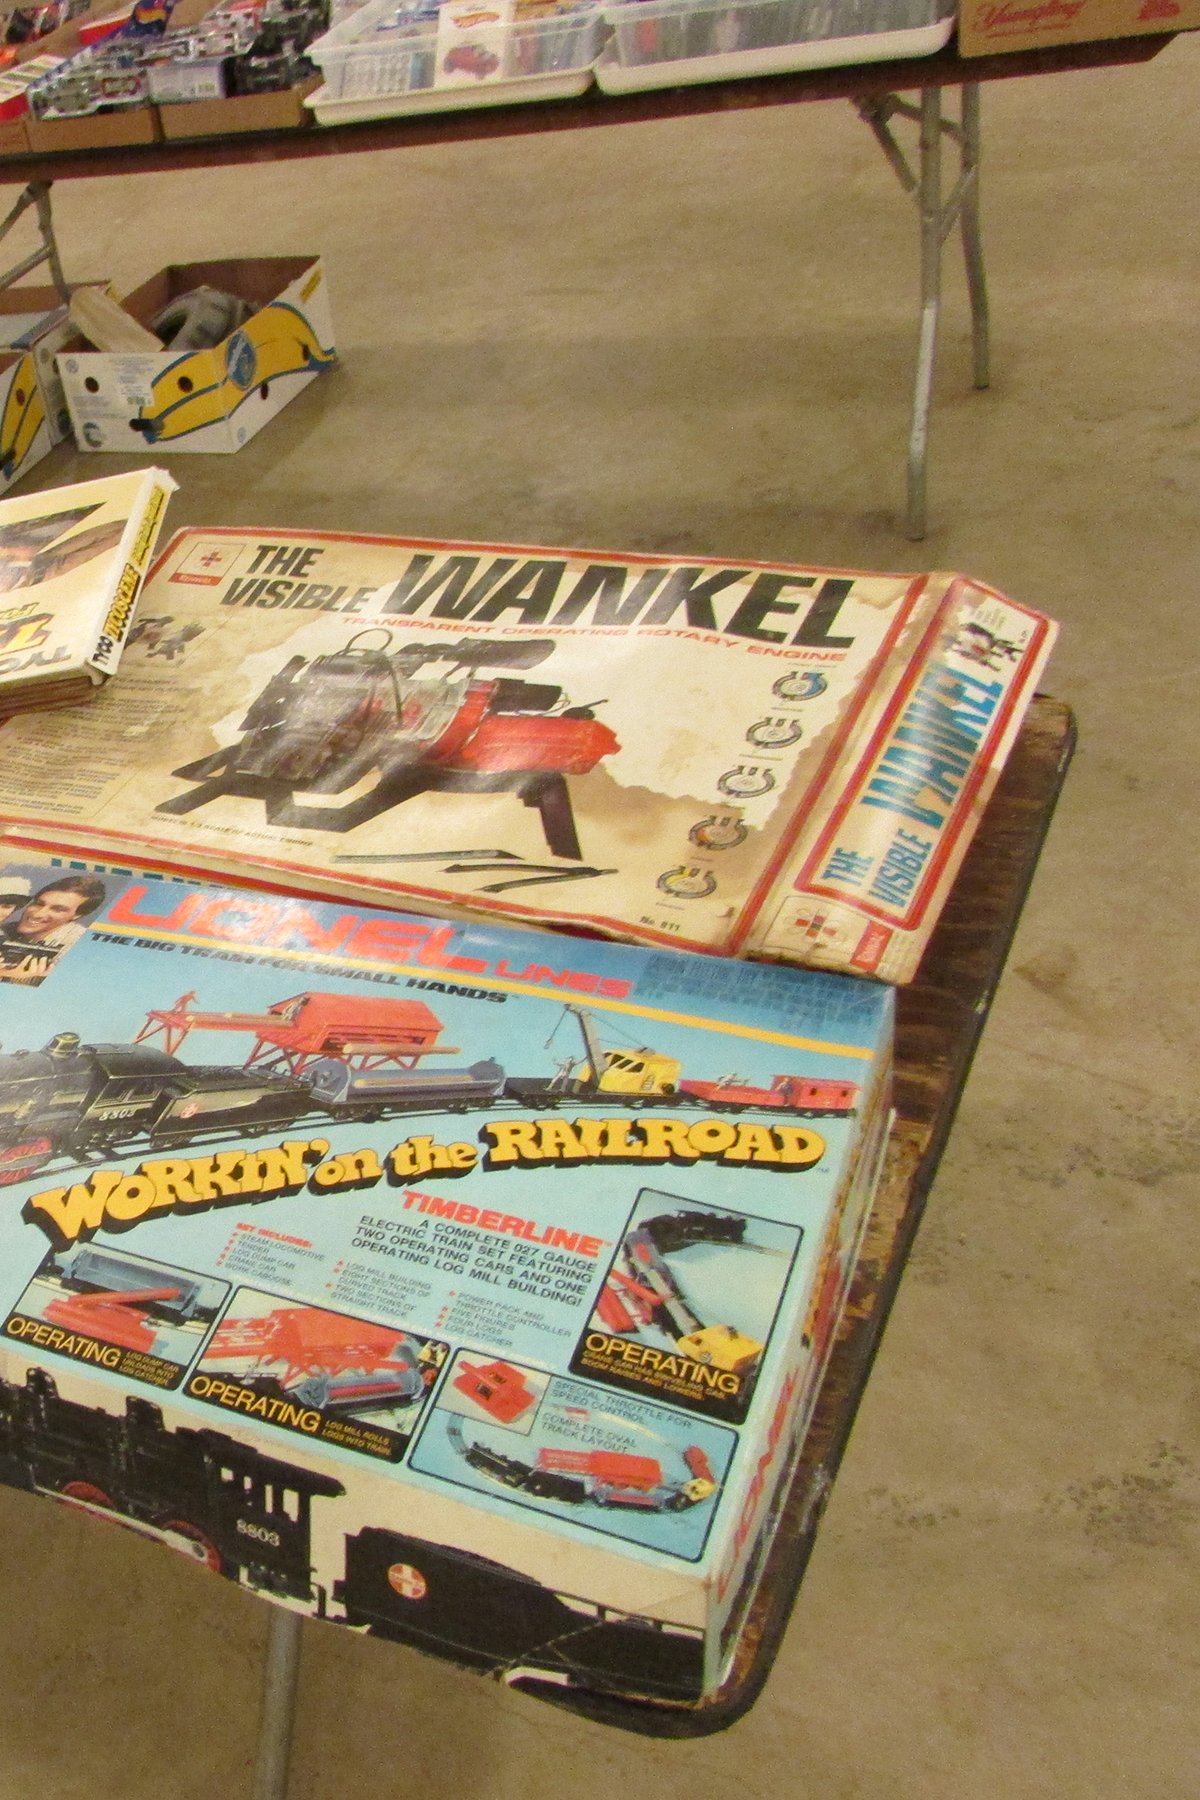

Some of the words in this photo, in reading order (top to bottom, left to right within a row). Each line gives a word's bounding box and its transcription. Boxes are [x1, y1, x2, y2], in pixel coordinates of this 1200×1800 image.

[246, 544, 325, 578] THE
[219, 577, 381, 614] VISIBLE
[379, 553, 855, 649] WANKEL
[341, 617, 496, 634] TRANSPARENT
[501, 627, 629, 637] OPERATING
[637, 629, 740, 649] ROTARY
[745, 645, 848, 663] ENGINE
[821, 847, 876, 887] THE
[867, 827, 933, 909] VISIBLE
[90, 932, 133, 946] THE
[135, 938, 177, 952] BIG
[180, 945, 256, 964] TRAIN
[311, 965, 402, 986] SMALL
[405, 977, 509, 1004] HANDS
[107, 886, 489, 974] LIONEL
[493, 959, 635, 1000] LINES
[480, 1117, 828, 1174] RAILROAD
[22, 1138, 332, 1248] WORKIN'
[310, 1149, 384, 1195] on
[388, 1135, 479, 1187] the
[360, 1215, 431, 1240] ELECTRIC
[431, 1233, 474, 1251] TRAIN
[478, 1245, 505, 1258] SET
[508, 1252, 593, 1284] FEATURING
[402, 1189, 604, 1258] TIMBERLINE
[419, 1220, 429, 1229] A
[434, 1222, 511, 1250] COMPLETE
[543, 1251, 598, 1273] GAUGE
[351, 1238, 431, 1266] OPERATING
[433, 1261, 465, 1276] LOG
[468, 1269, 502, 1286] MILL
[507, 1279, 584, 1309] BUILDING!
[355, 1226, 386, 1242] TWO
[390, 1235, 470, 1264] OPERATING
[474, 1257, 515, 1276] CARS
[519, 1270, 552, 1285] AND
[555, 1280, 588, 1296] ONE
[6, 1316, 122, 1368] OPERATING
[585, 1333, 741, 1395] OPERATING
[189, 1375, 322, 1433] OPERATING
[554, 1381, 601, 1401] SPECIAL
[541, 1421, 580, 1441] TRACK
[580, 1433, 629, 1453] LAYOUT
[543, 1413, 603, 1436] COMPLETE
[236, 1518, 282, 1548] 8803
